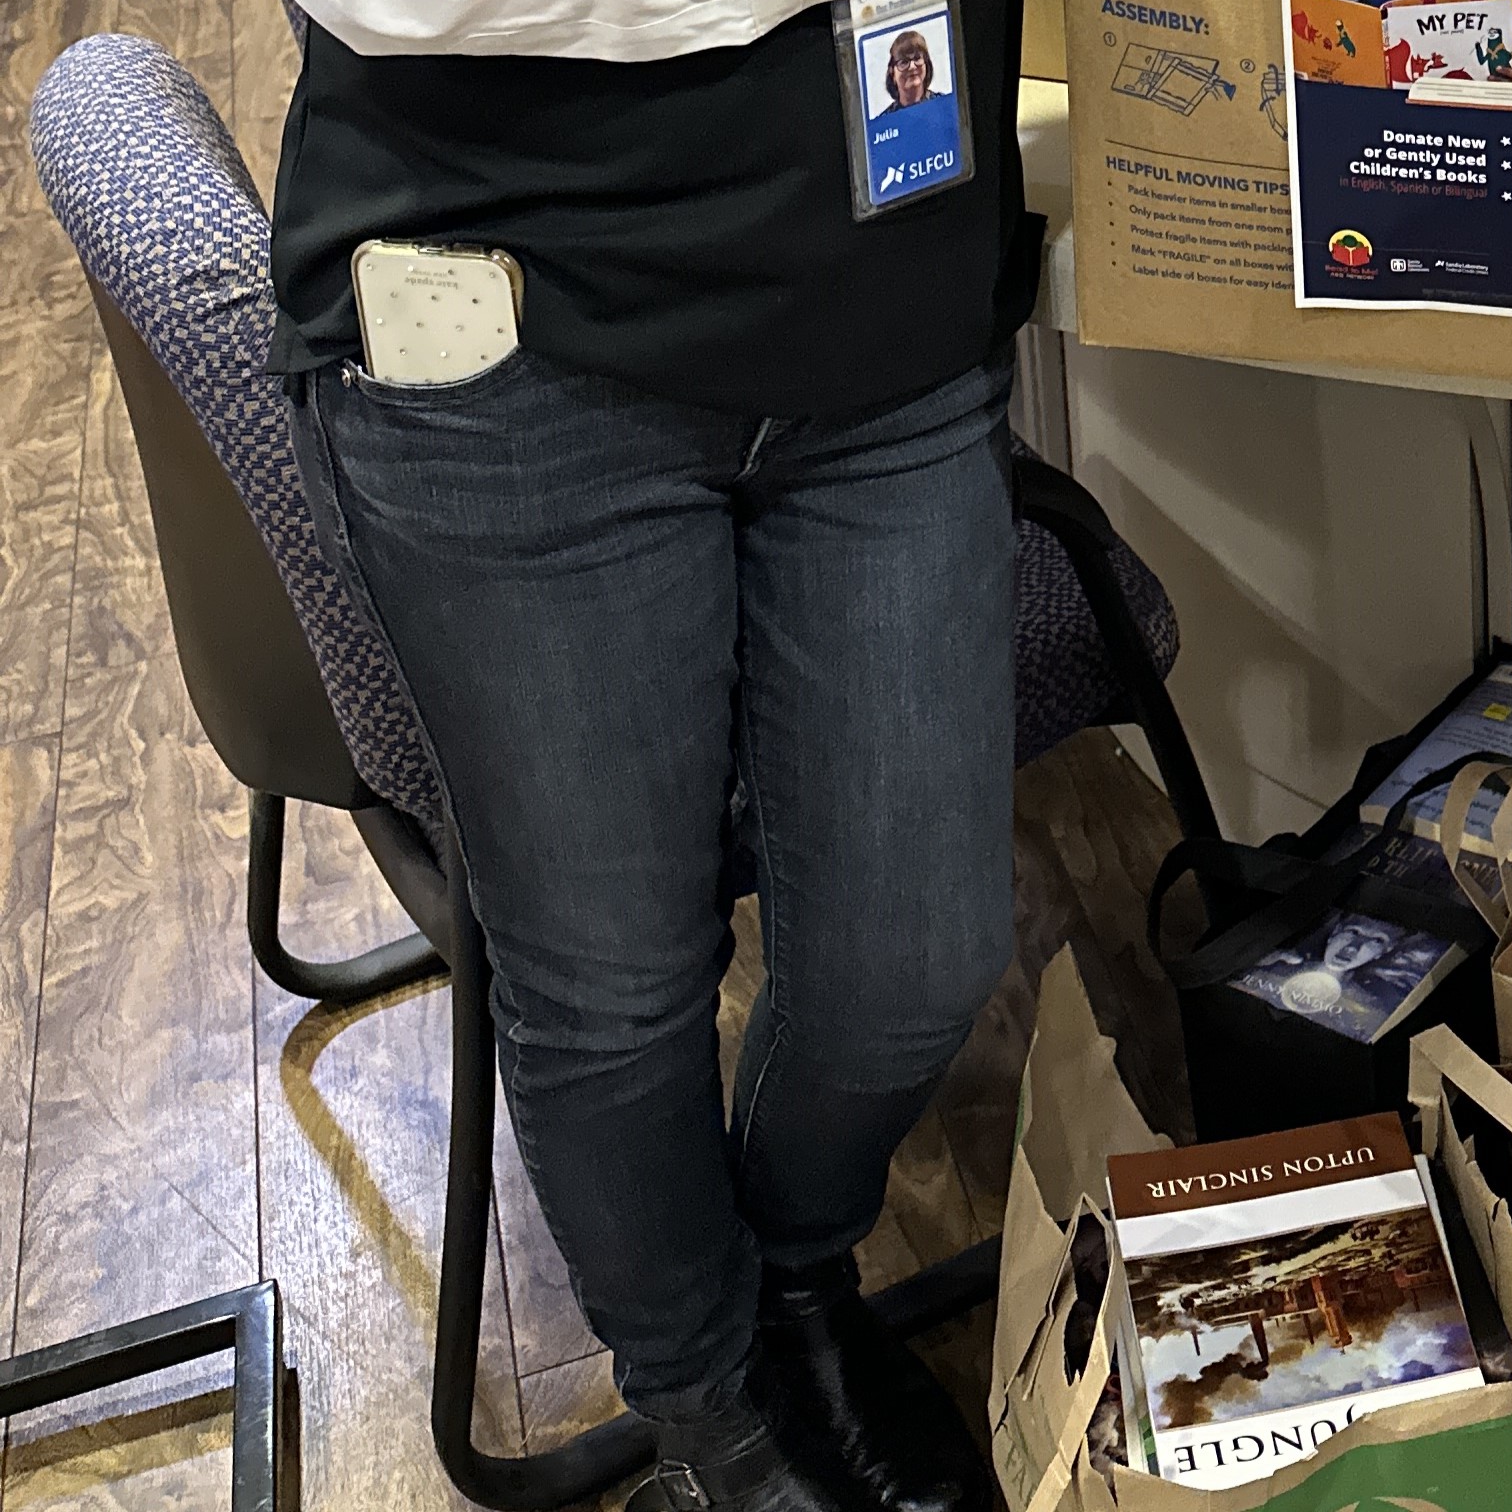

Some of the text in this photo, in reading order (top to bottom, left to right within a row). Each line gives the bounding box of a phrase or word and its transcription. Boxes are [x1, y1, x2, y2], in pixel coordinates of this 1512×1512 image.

[1416, 12, 1488, 36] MY PET
[874, 128, 900, 144] Julia
[1383, 130, 1486, 149] Donate New
[908, 150, 954, 180] SLFCU
[1364, 148, 1486, 166] or Gently Used
[1106, 156, 1290, 196] HELPFUL MOVING TIPS
[1350, 161, 1487, 184] Children's Books
[1128, 184, 1268, 214] Pack heavier items in smaller
[1390, 180, 1430, 195] Spanish
[1431, 186, 1442, 196] or
[1129, 204, 1152, 220] Only
[1153, 210, 1177, 222] pack
[1179, 214, 1206, 226] items
[1208, 217, 1232, 230] from
[1256, 224, 1284, 234] room
[1130, 224, 1294, 256] Protect fragile items with packing
[1131, 244, 1156, 257] Mark
[1213, 257, 1227, 265] on
[1229, 256, 1242, 268] all
[1243, 260, 1274, 271] boxes
[1132, 264, 1269, 290] Label side of boxes for easy
[1147, 1146, 1376, 1200] UPTON SINCLAIR
[1174, 1404, 1357, 1473] UNGLE
